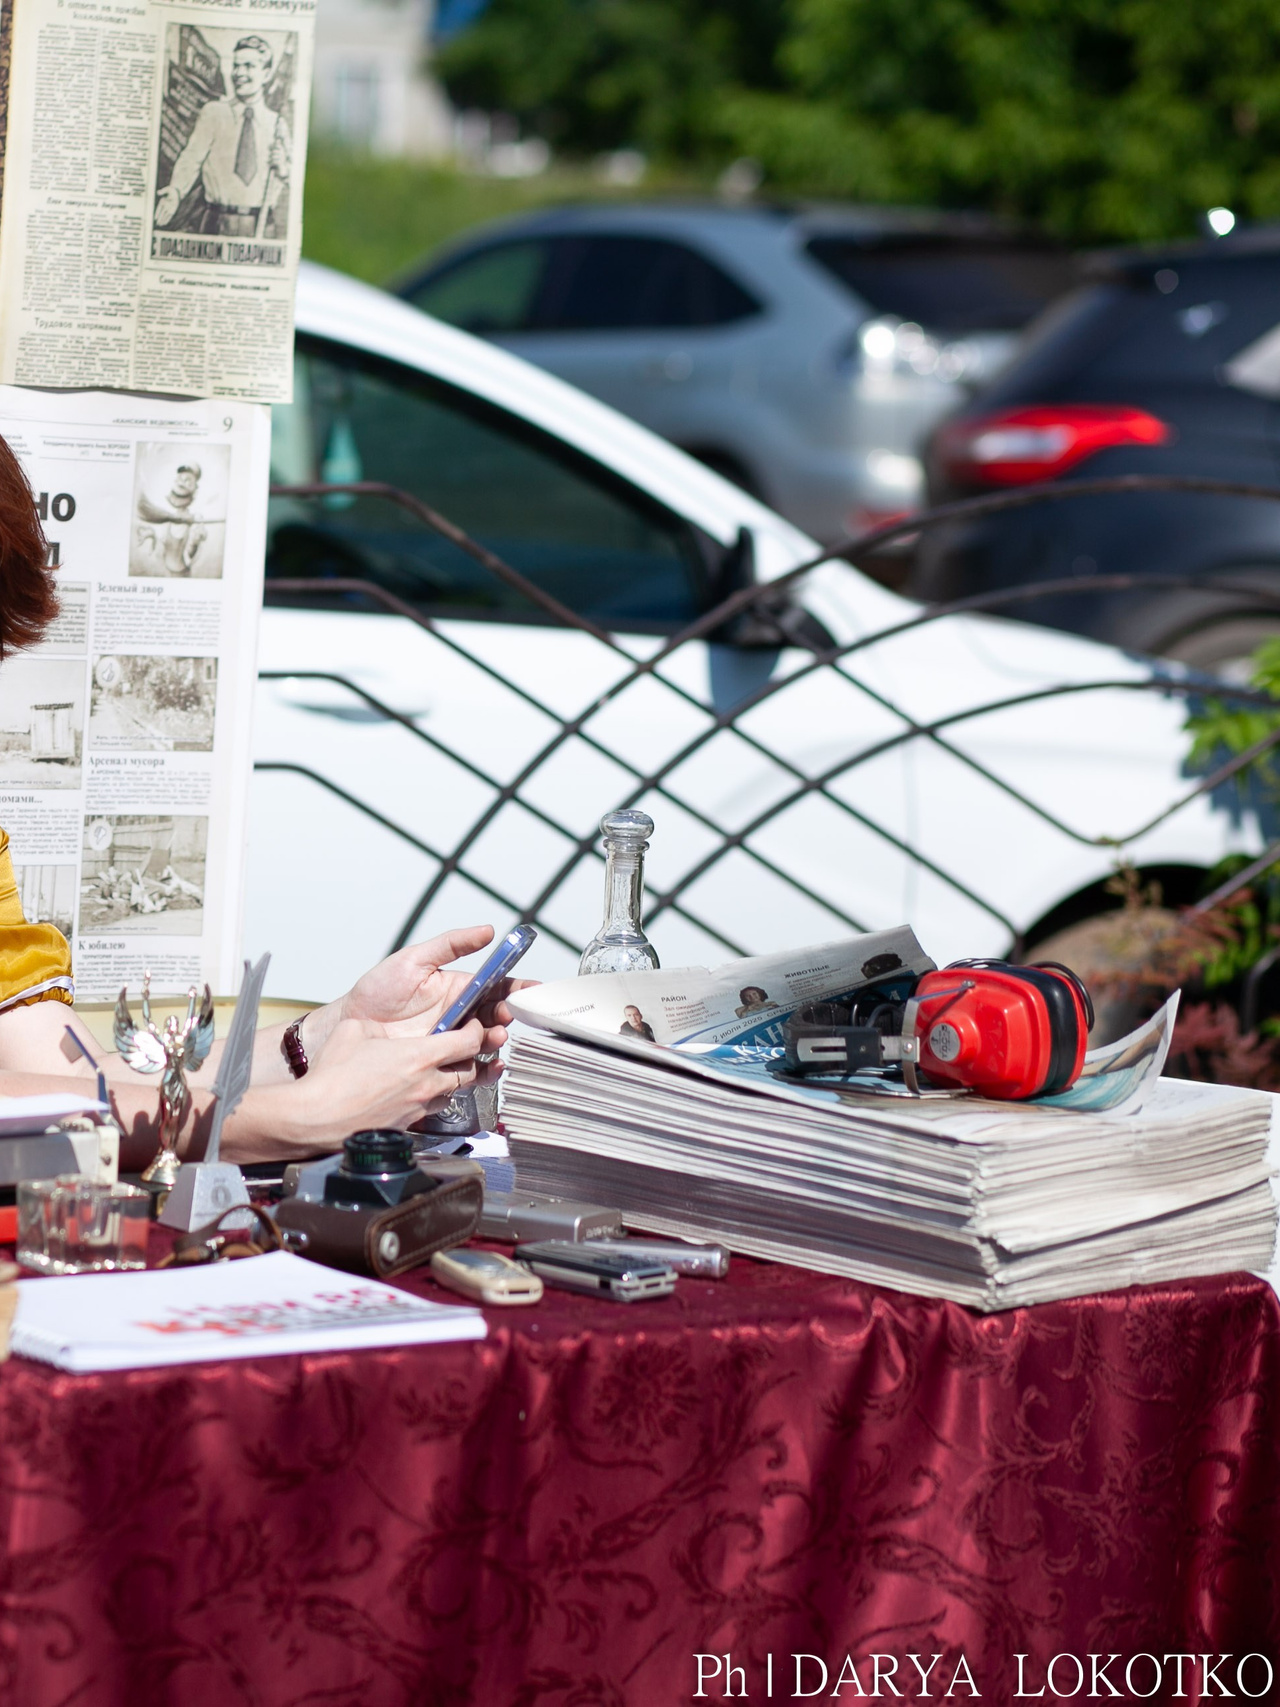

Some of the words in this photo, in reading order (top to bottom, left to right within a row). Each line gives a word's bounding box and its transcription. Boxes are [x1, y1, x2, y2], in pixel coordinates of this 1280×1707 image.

[160, 238, 223, 262] ПРАЗДНИКОМ
[223, 417, 233, 432] 9
[142, 585, 164, 596] двор
[88, 756, 127, 766] Арсенал
[131, 758, 165, 768] мусора
[78, 940, 86, 950] К
[88, 941, 126, 950] юбилею
[784, 965, 830, 978] ЖИВОТНЫЕ
[660, 994, 687, 1003] РАЙОН
[712, 1035, 719, 1043] 2
[720, 1025, 741, 1039] июля
